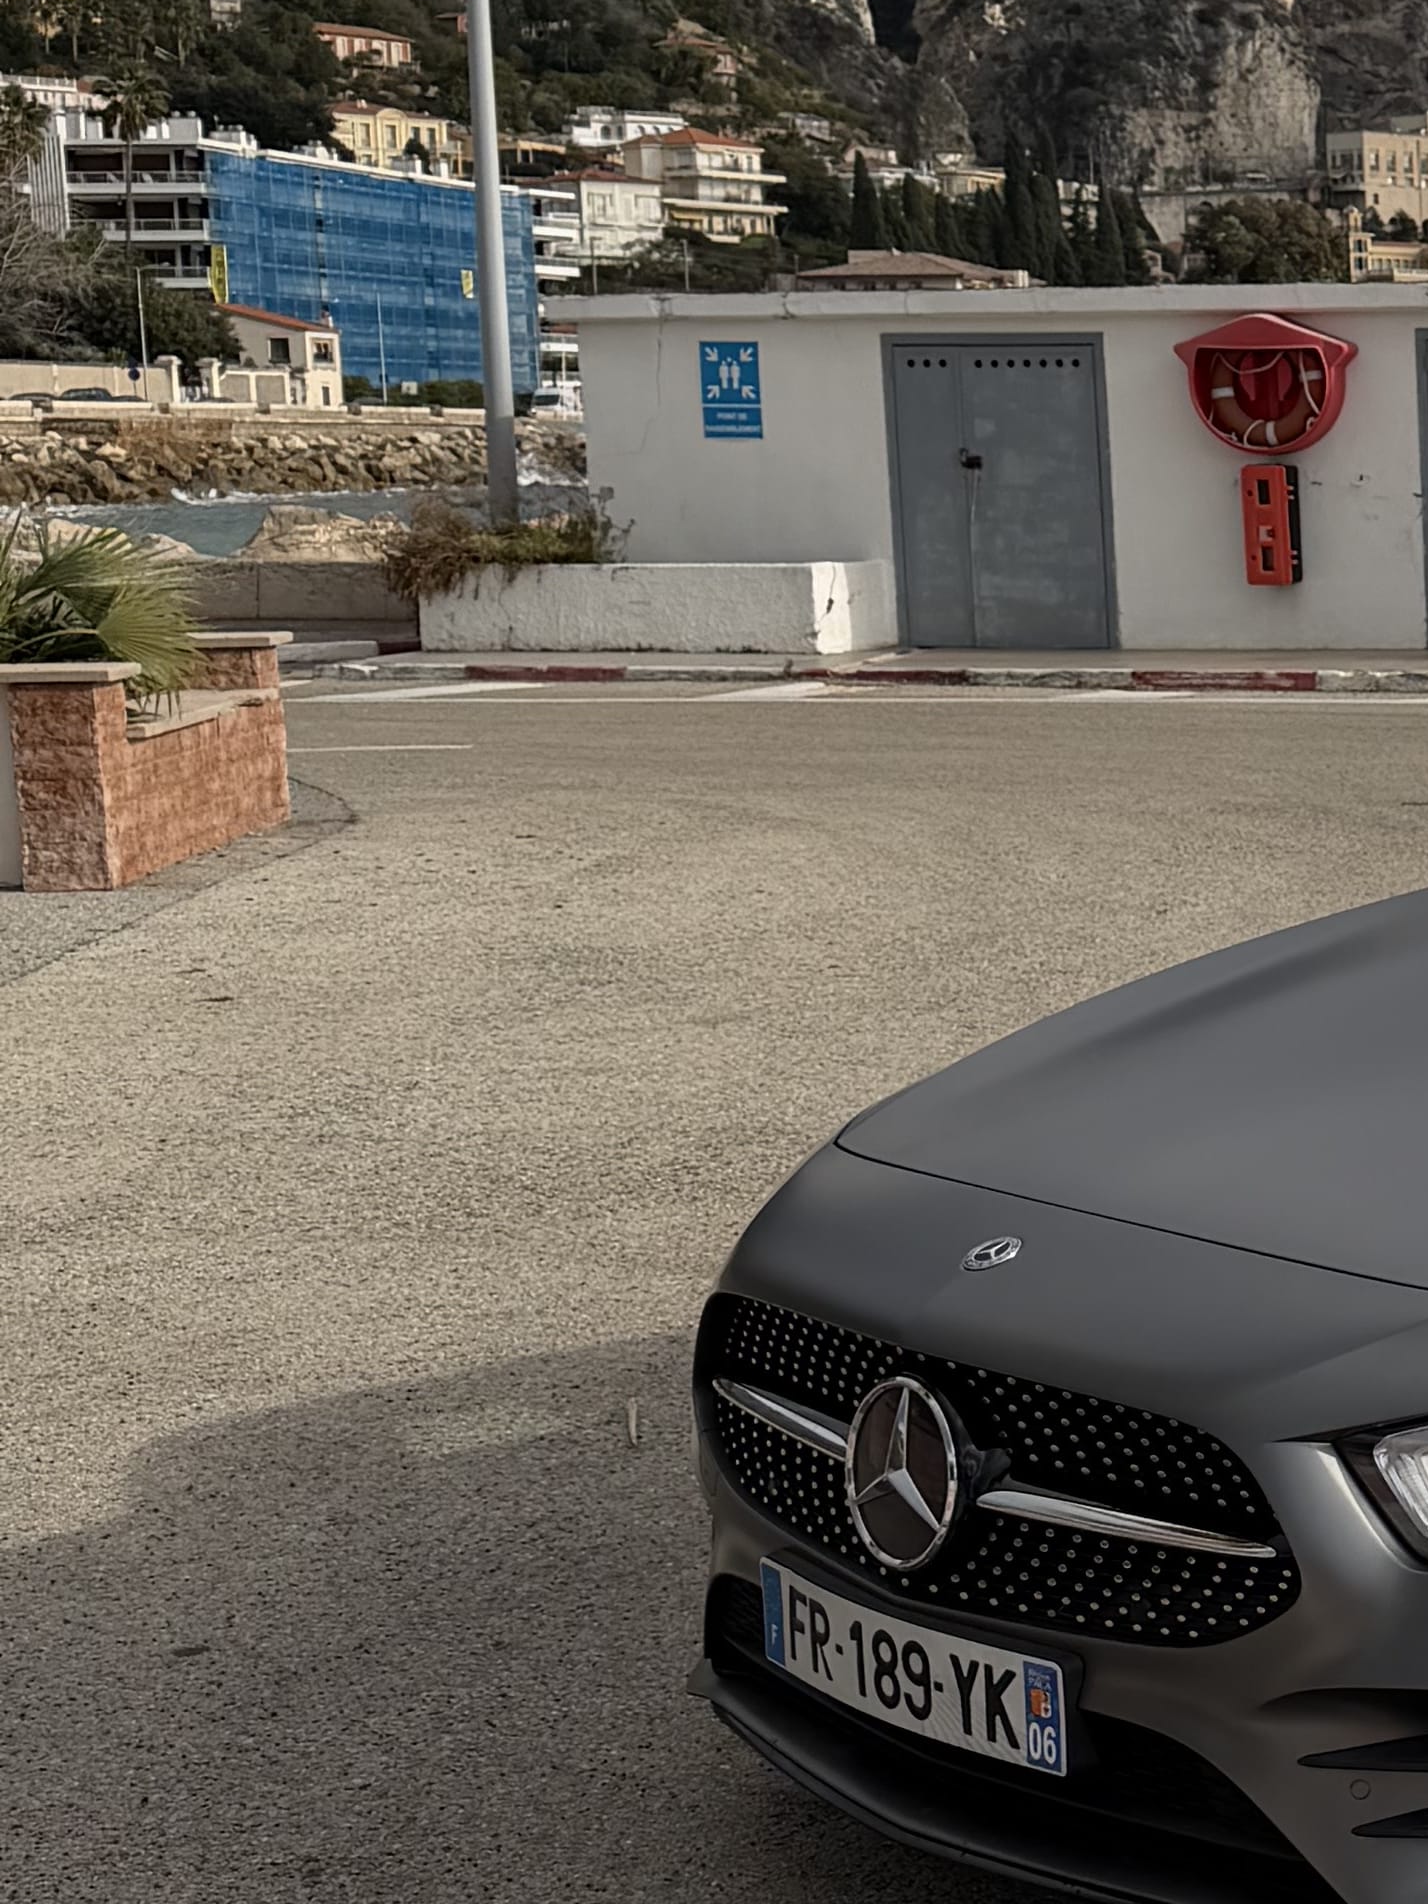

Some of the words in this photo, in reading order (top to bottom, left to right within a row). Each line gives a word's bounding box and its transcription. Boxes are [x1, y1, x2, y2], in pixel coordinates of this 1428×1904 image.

[770, 1623, 779, 1646] F
[788, 1583, 1020, 1750] FR-189-YK
[1028, 1721, 1056, 1766] 06
